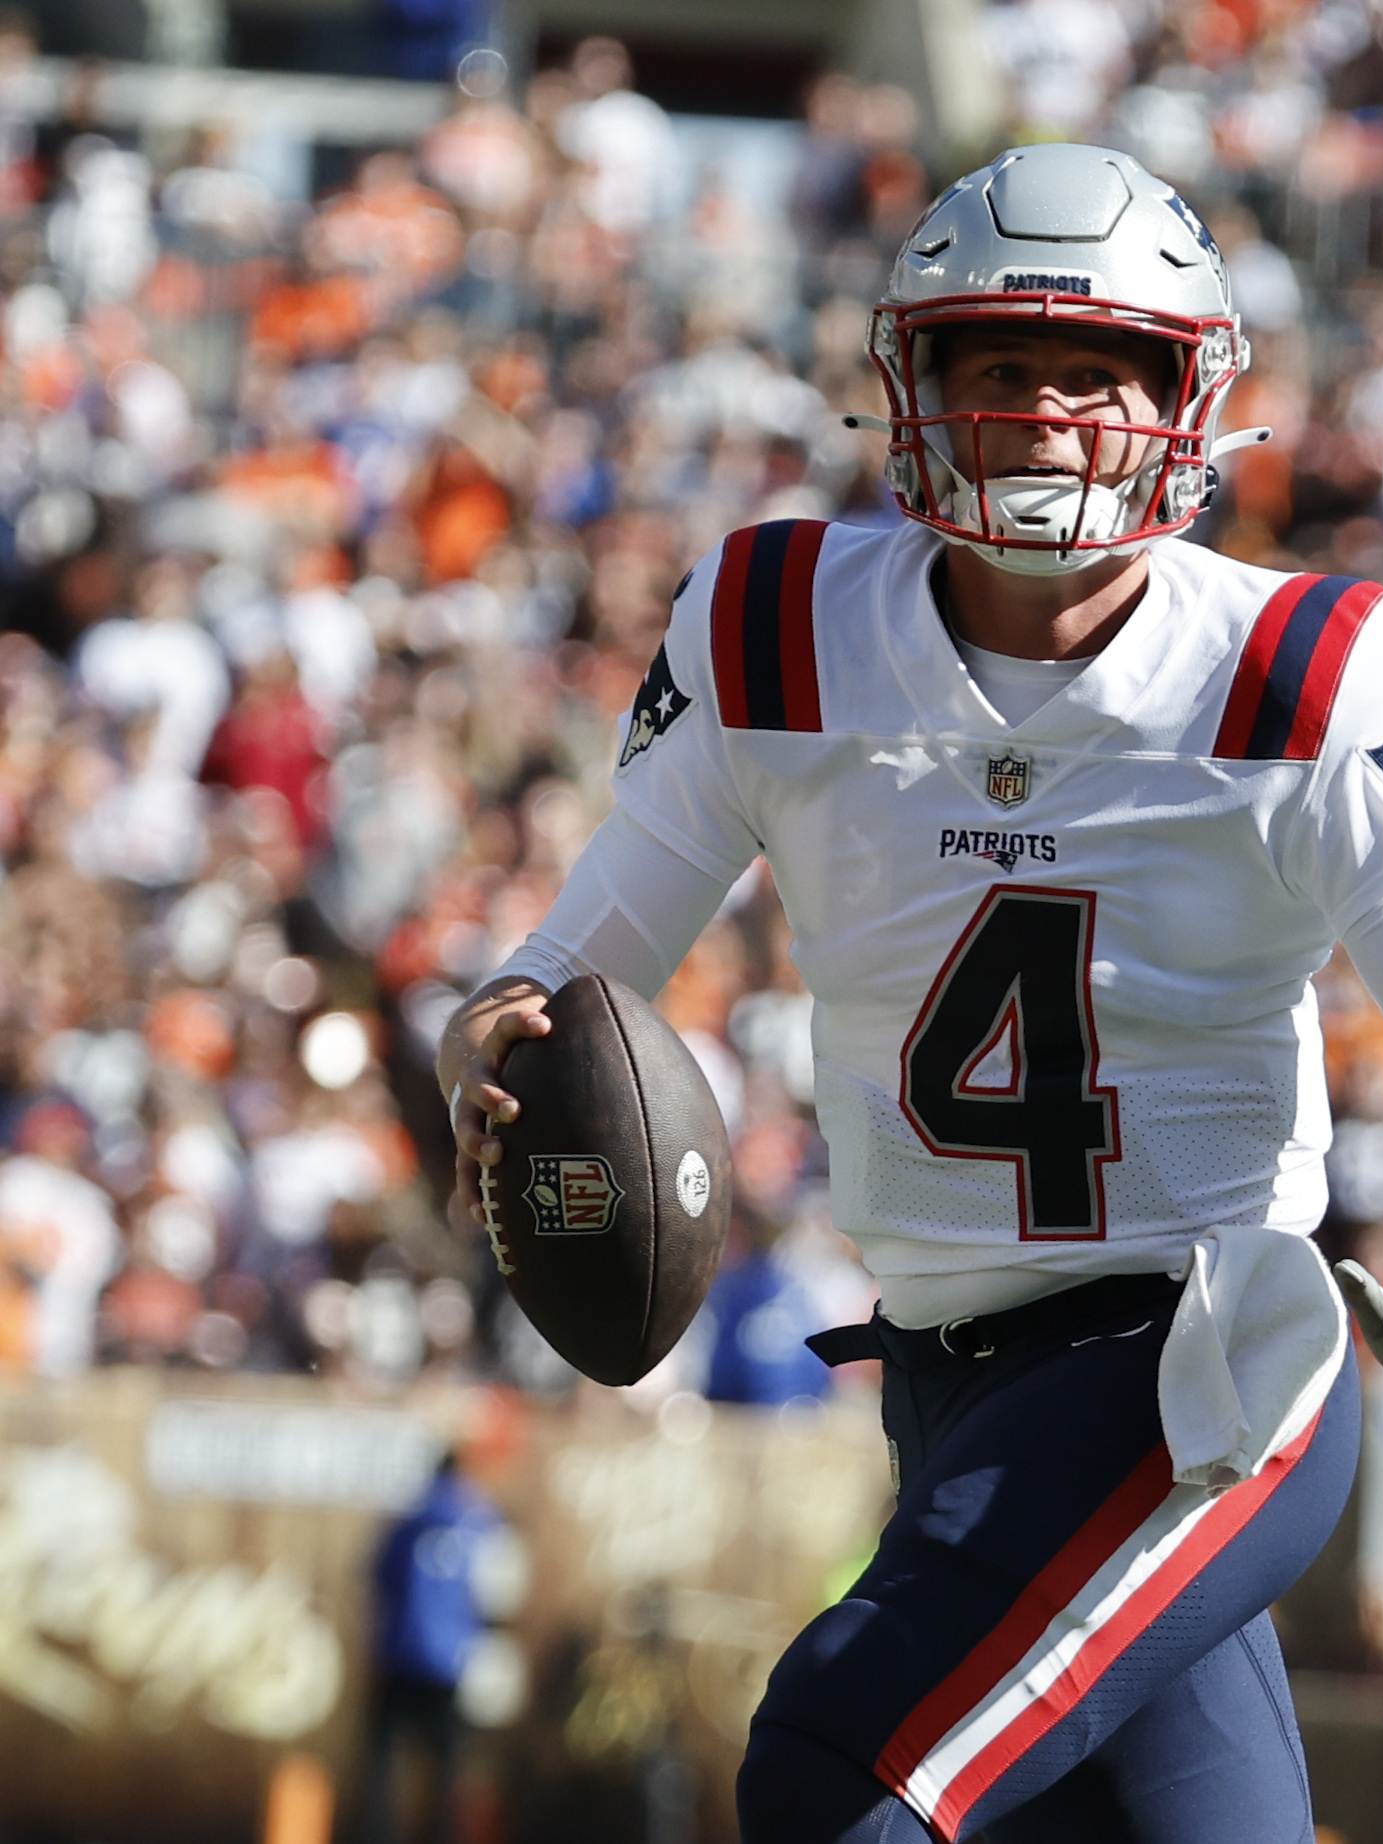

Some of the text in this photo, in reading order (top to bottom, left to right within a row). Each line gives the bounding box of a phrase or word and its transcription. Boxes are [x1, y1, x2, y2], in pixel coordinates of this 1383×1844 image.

[1003, 273, 1091, 297] PATRIOTS
[991, 776, 1021, 799] NFL
[939, 829, 1056, 862] PATRIOTS
[899, 883, 1122, 1242] 4
[563, 1163, 609, 1226] NFL
